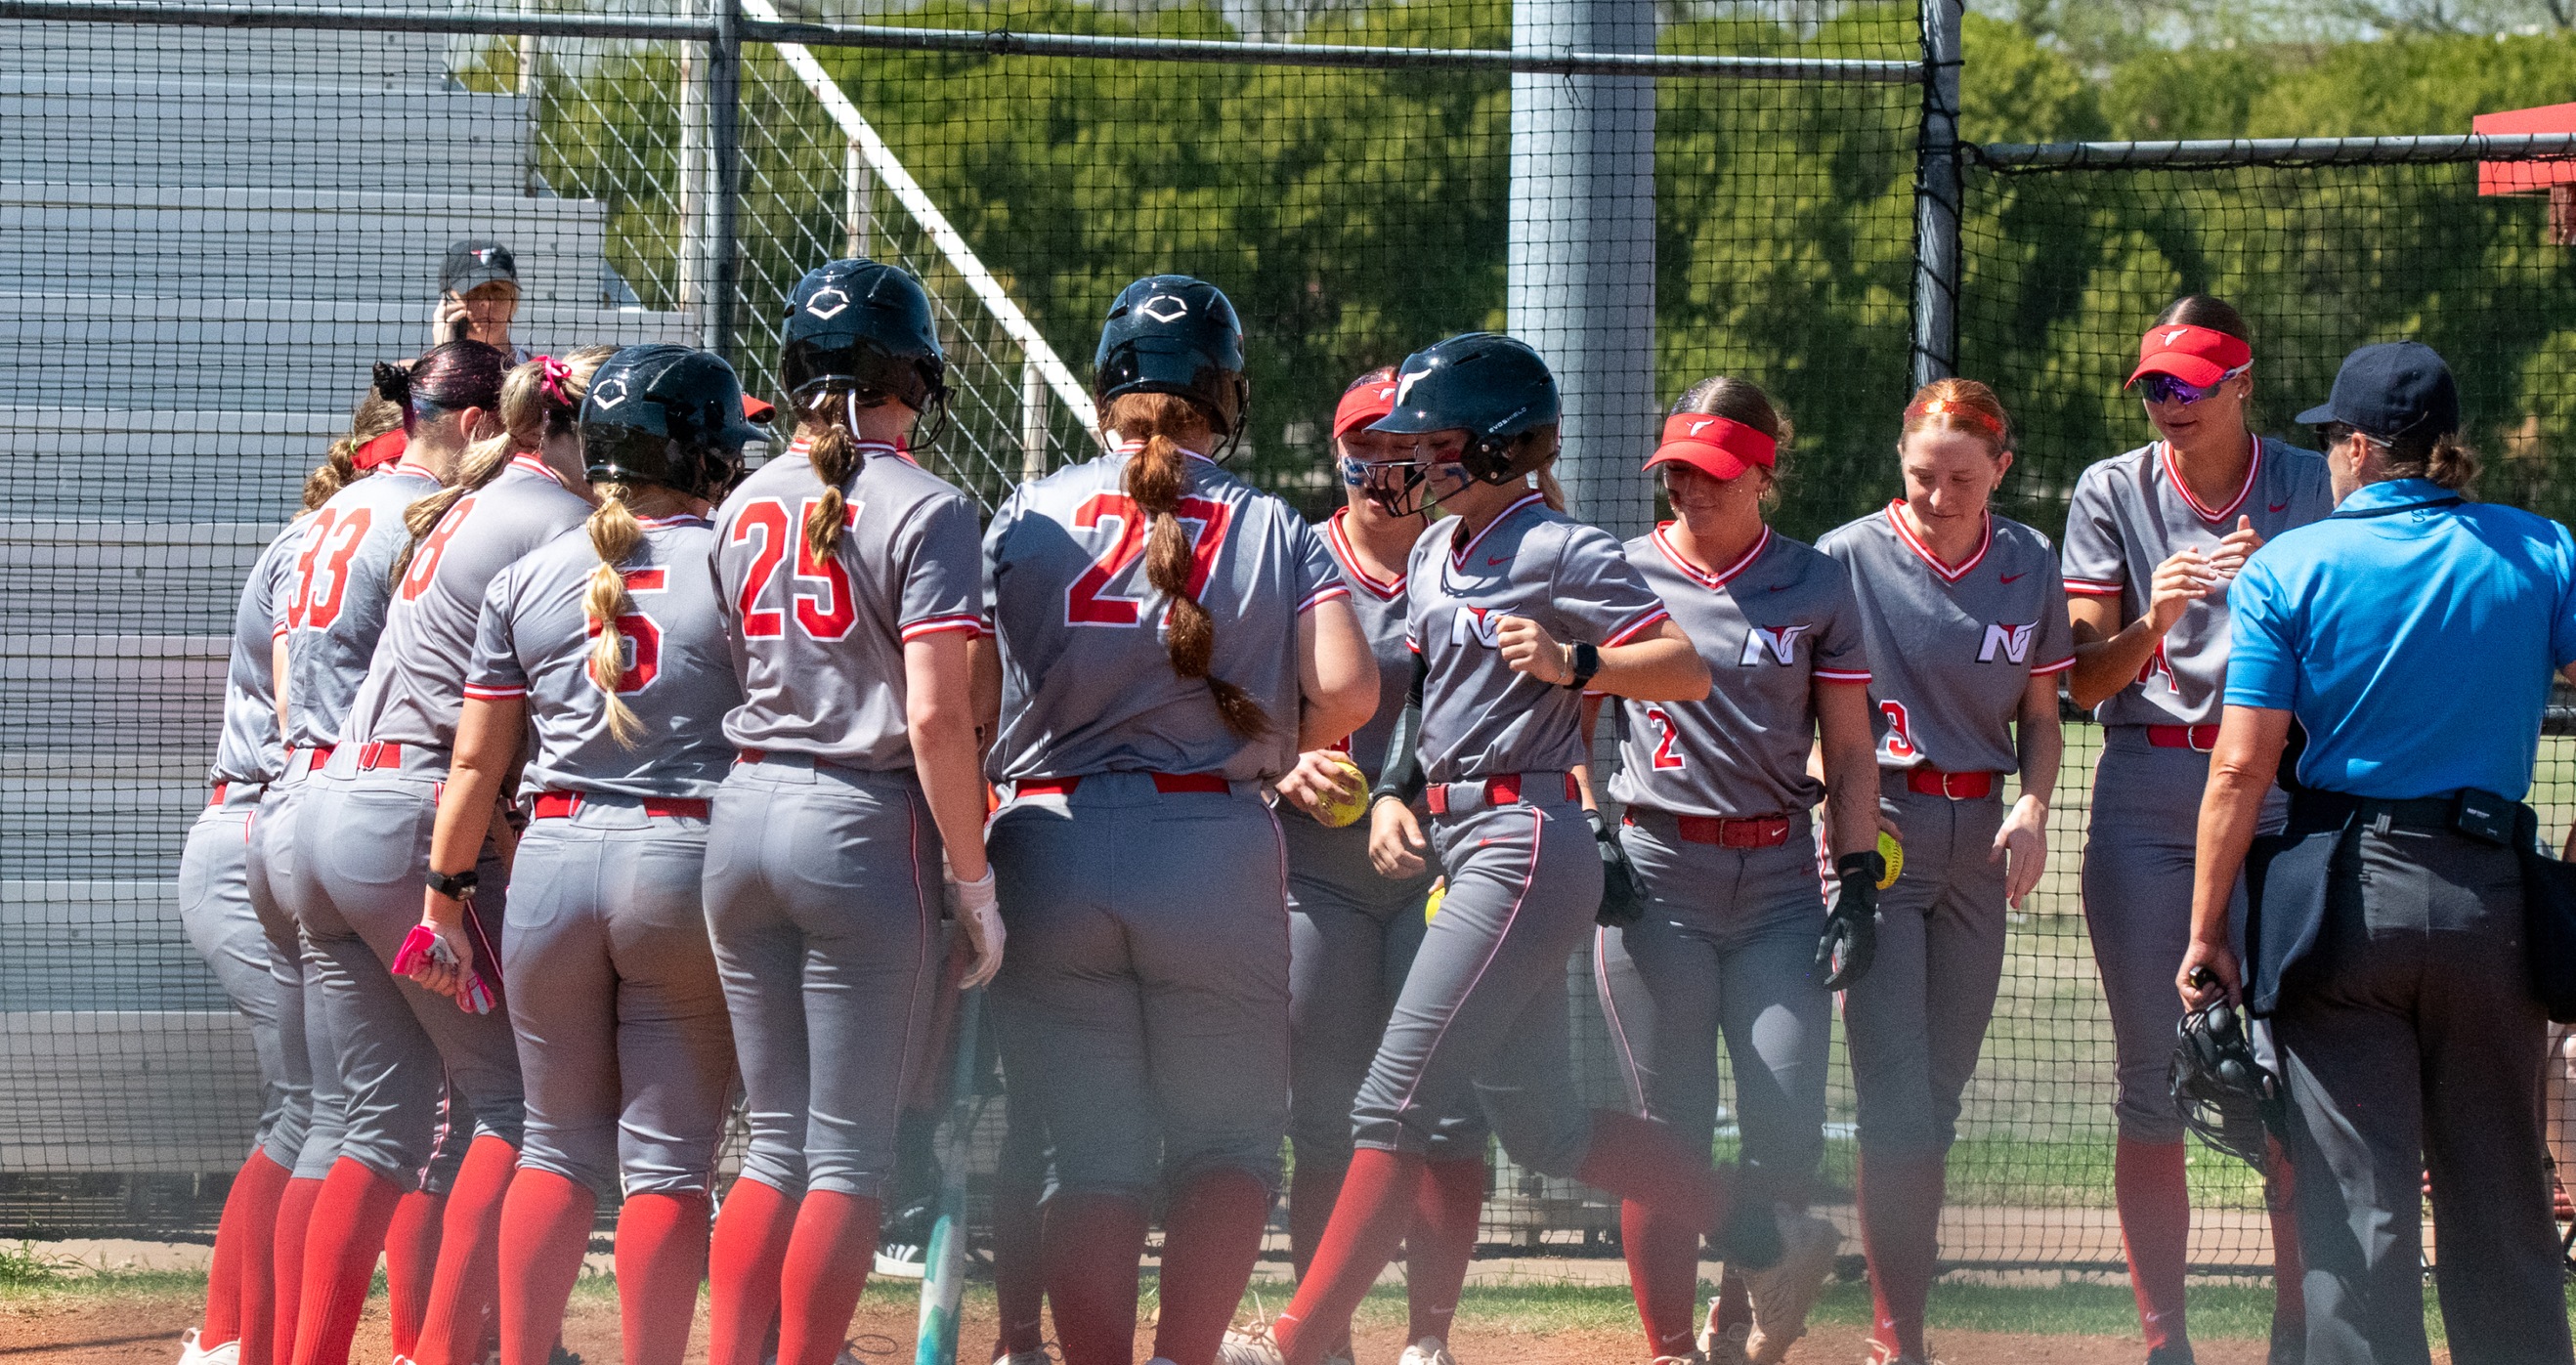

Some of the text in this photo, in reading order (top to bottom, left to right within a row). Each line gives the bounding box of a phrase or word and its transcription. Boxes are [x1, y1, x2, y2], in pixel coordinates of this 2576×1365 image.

[286, 505, 374, 634] 33
[730, 495, 867, 643] 25
[1064, 490, 1234, 629] 27
[1647, 706, 1687, 771] 2
[1878, 699, 1917, 760] 9
